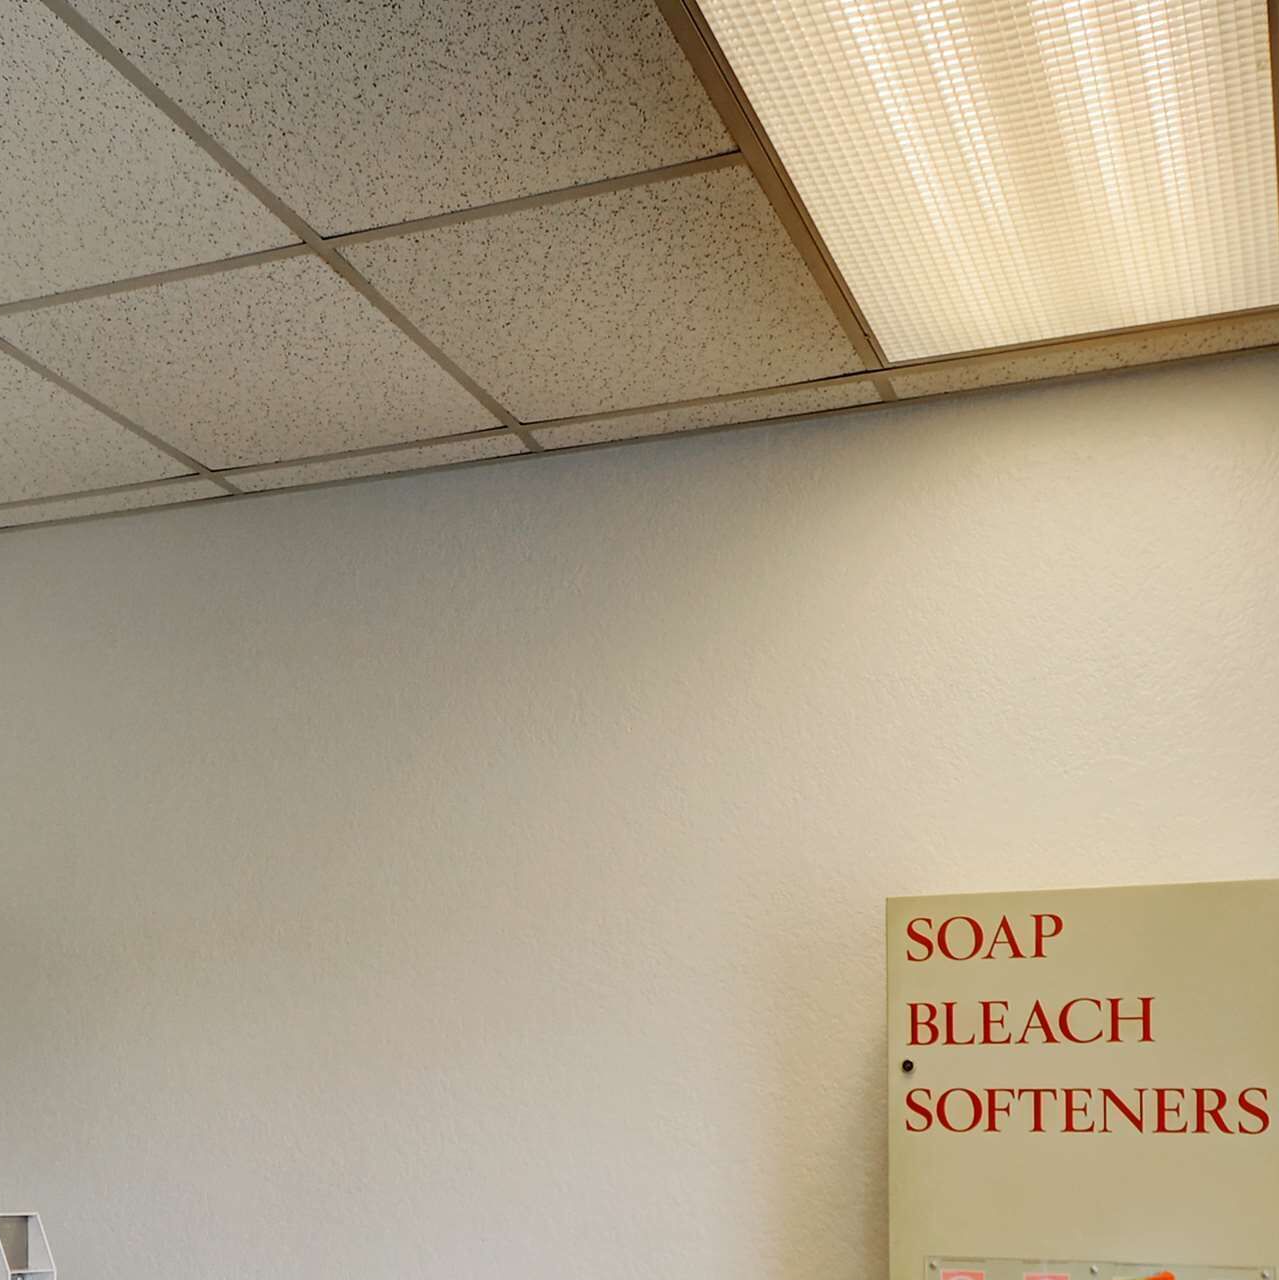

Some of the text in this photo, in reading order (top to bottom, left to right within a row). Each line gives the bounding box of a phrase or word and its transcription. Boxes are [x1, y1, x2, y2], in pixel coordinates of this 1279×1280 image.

[906, 913, 1063, 962] SOAP
[906, 996, 1155, 1046] BLEACH
[905, 1087, 1270, 1134] SOFTENERS
